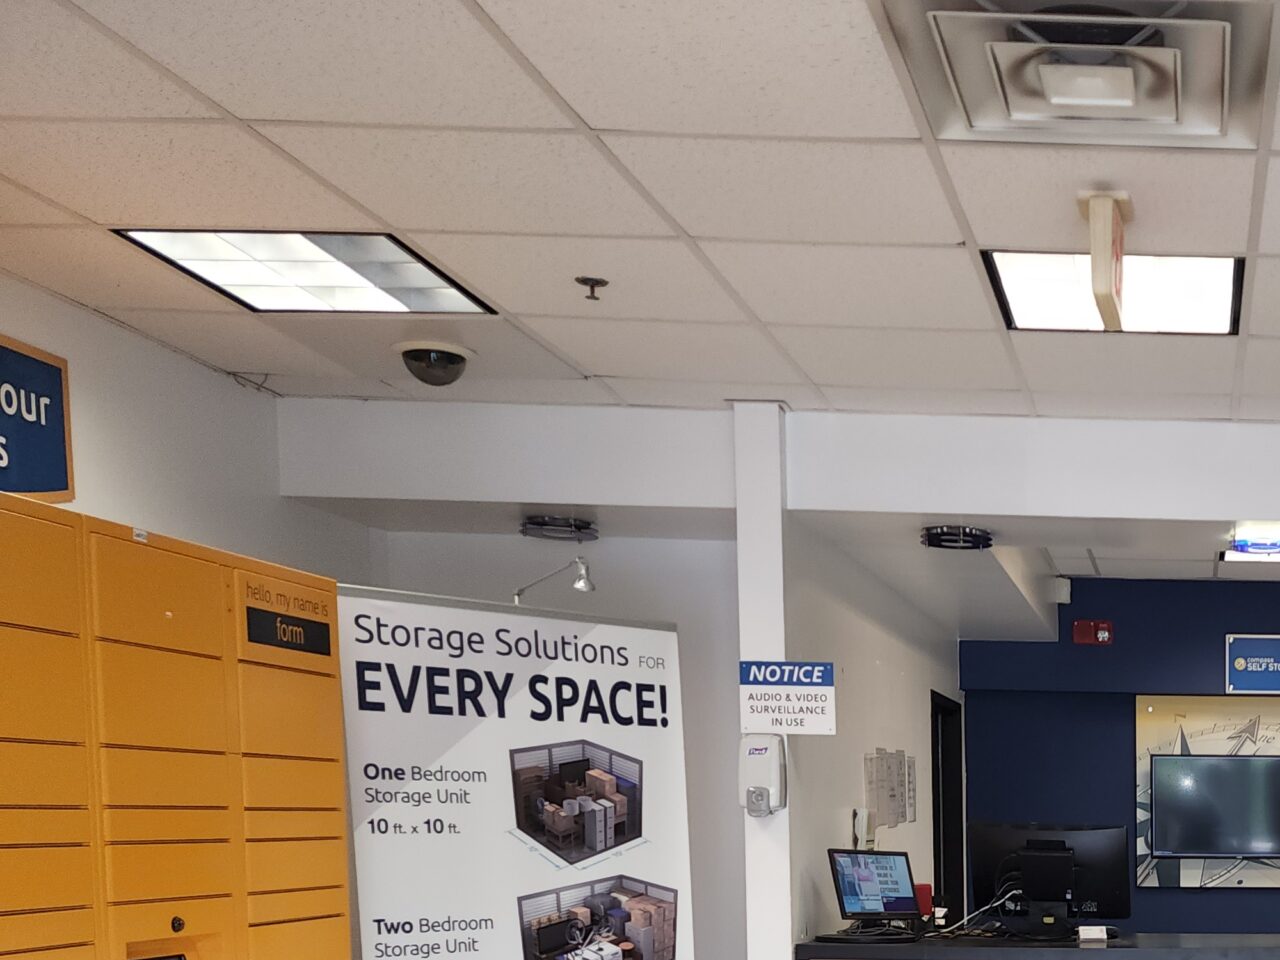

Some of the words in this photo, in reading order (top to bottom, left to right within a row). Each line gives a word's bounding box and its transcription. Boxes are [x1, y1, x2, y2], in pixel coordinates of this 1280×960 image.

[246, 581, 273, 605] hello,
[276, 592, 291, 612] my
[293, 597, 319, 614] name
[321, 600, 329, 616] is
[276, 617, 304, 645] form
[353, 614, 485, 658] Storage
[494, 629, 629, 667] Solutions
[638, 655, 666, 671] FOR
[749, 665, 825, 683] NOTICE
[1247, 663, 1267, 672] SELF
[355, 660, 514, 719] EVERY
[528, 674, 669, 728] SPACE!
[748, 693, 783, 703] AUDIO
[785, 693, 792, 702] &
[795, 693, 828, 703] VIDEO
[749, 705, 827, 715] SURVEILLANCE
[771, 717, 783, 727] IN
[786, 718, 805, 727] USE
[363, 763, 406, 781] One
[411, 765, 488, 783] Bedroom
[364, 787, 432, 807] Storage
[437, 788, 472, 805] Unit
[367, 818, 389, 835] 10
[392, 822, 408, 835] ft.
[411, 826, 419, 834] x
[423, 818, 445, 834] 10
[448, 822, 461, 835] ft.
[373, 918, 414, 935] Two
[418, 915, 494, 934] Bedroom
[374, 942, 441, 959] Storage
[446, 936, 479, 953] Unit
